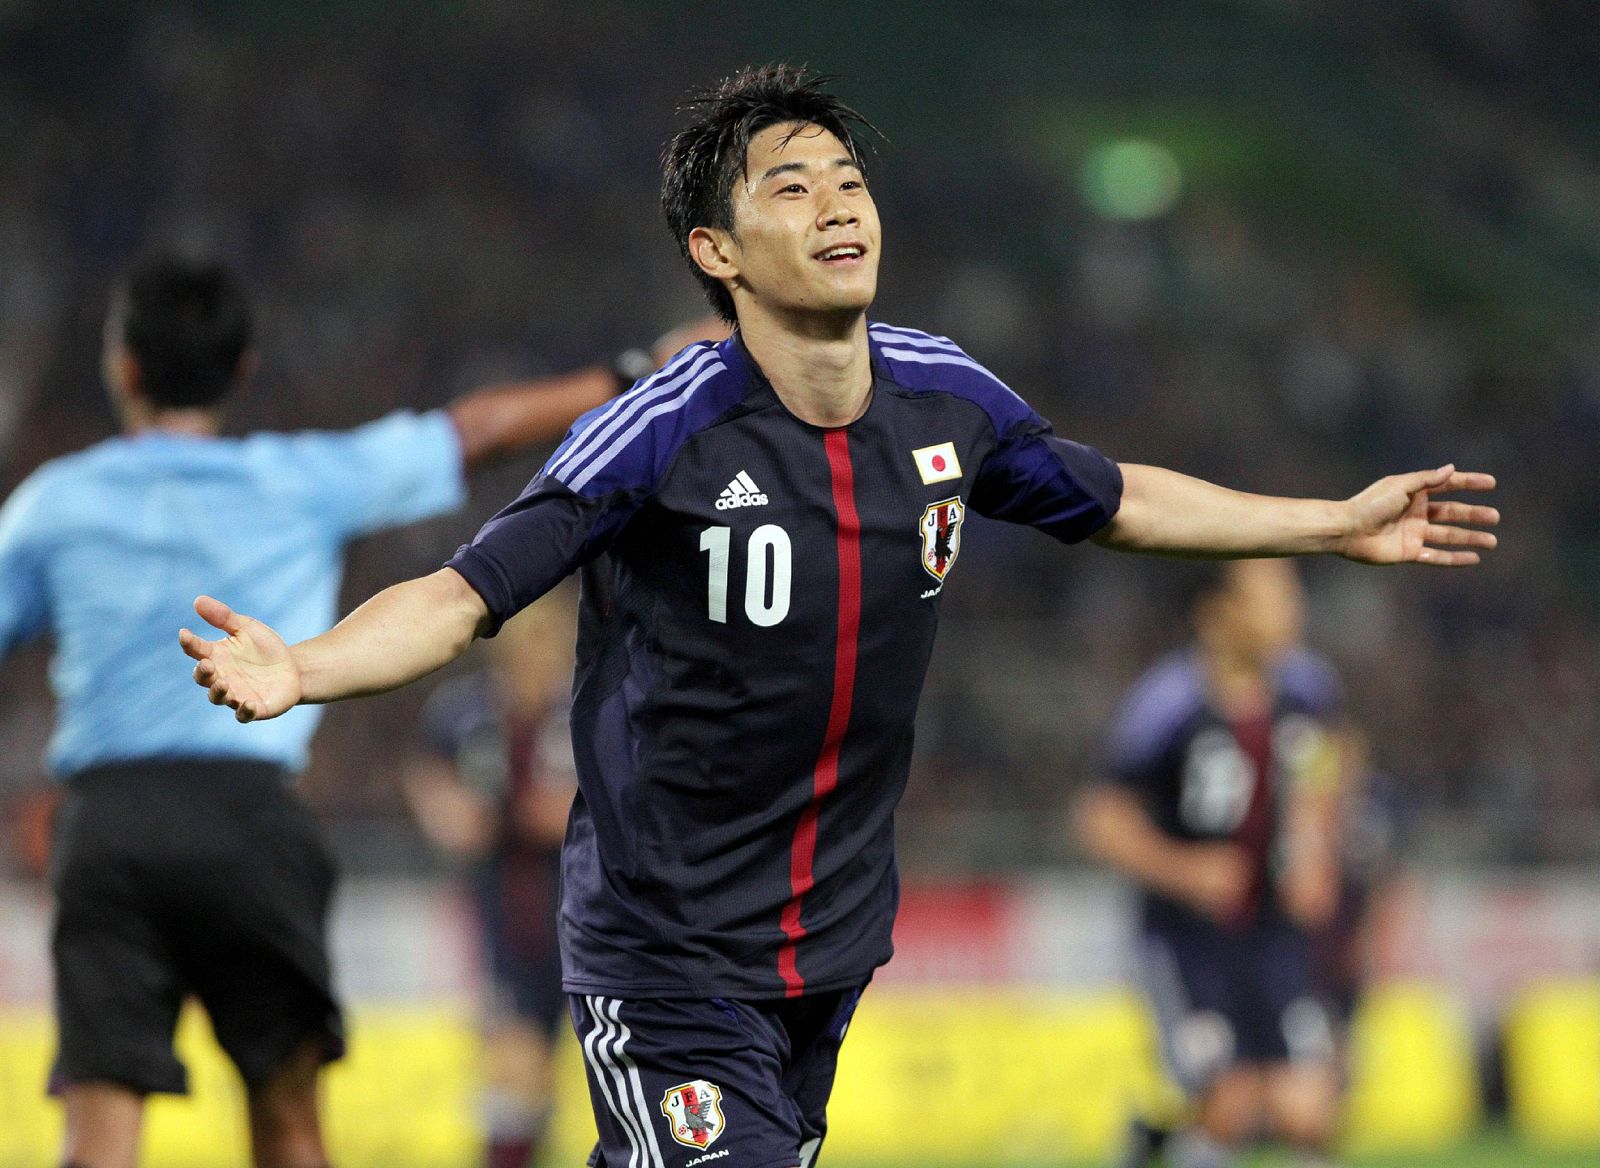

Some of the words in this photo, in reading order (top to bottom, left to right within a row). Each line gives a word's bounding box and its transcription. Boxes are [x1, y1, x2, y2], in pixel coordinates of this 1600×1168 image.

[715, 492, 769, 511] adidas
[927, 507, 957, 527] JFA
[699, 524, 792, 627] 10
[920, 587, 942, 599] JAP
[671, 1089, 711, 1108] JFA
[685, 1149, 730, 1168] JAPAN
